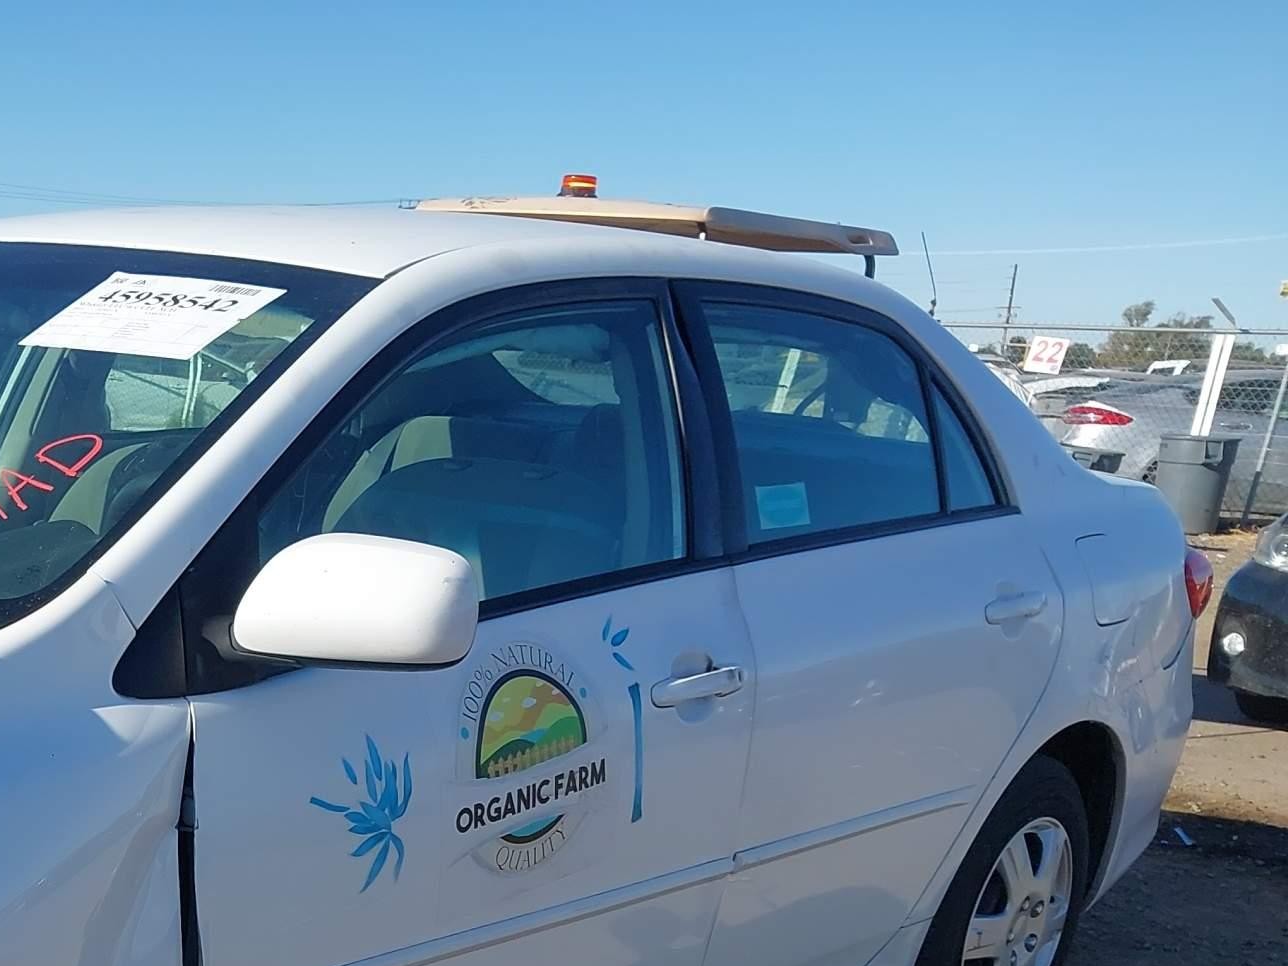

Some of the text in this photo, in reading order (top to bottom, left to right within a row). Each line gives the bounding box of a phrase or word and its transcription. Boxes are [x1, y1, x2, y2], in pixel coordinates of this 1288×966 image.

[98, 289, 239, 312] 45958542
[1031, 340, 1064, 363] 22
[462, 644, 577, 722] 100% NATURAL
[456, 758, 607, 833] ORGANIC FARM
[495, 826, 566, 871] QUALITY
